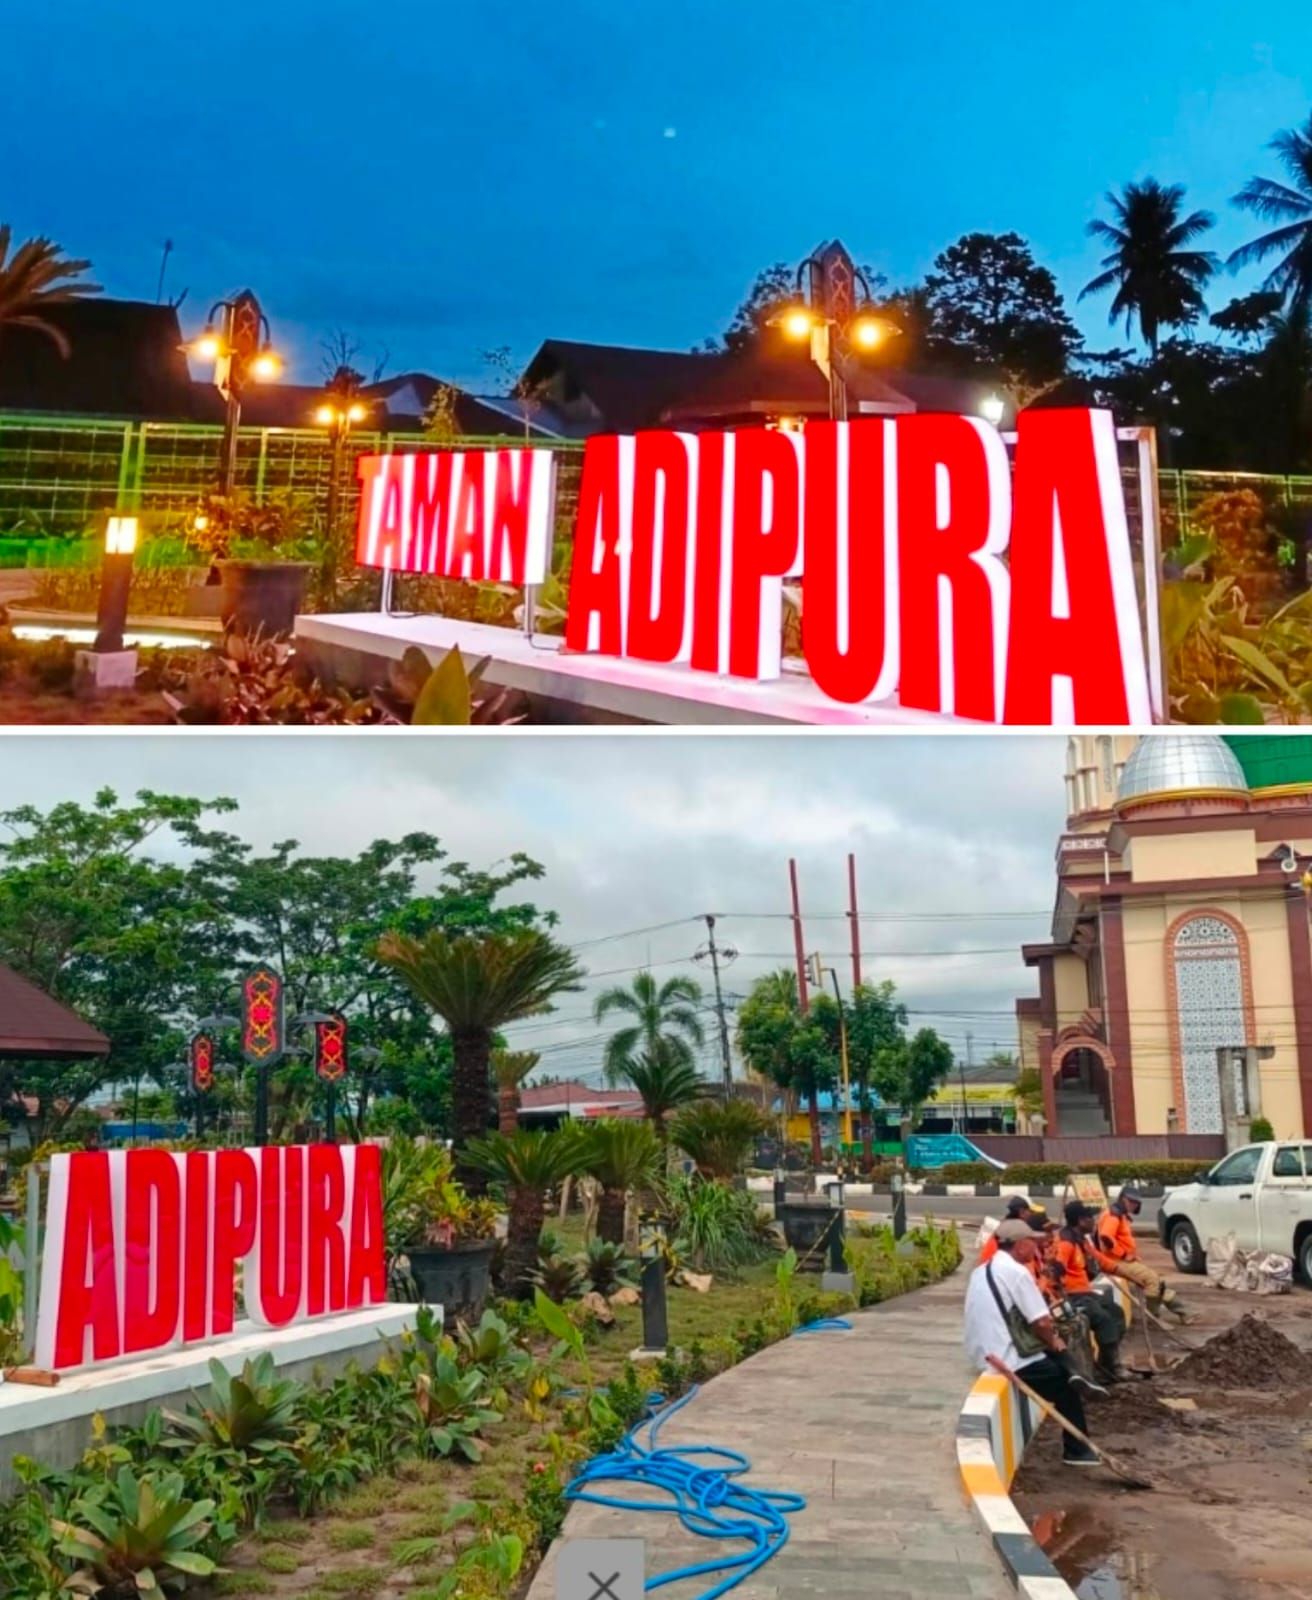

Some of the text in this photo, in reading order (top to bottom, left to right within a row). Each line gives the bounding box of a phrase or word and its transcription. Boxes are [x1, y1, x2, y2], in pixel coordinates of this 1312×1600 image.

[356, 407, 1135, 725] TAMAN ADIPURA
[53, 1144, 388, 1369] ADIPURA
